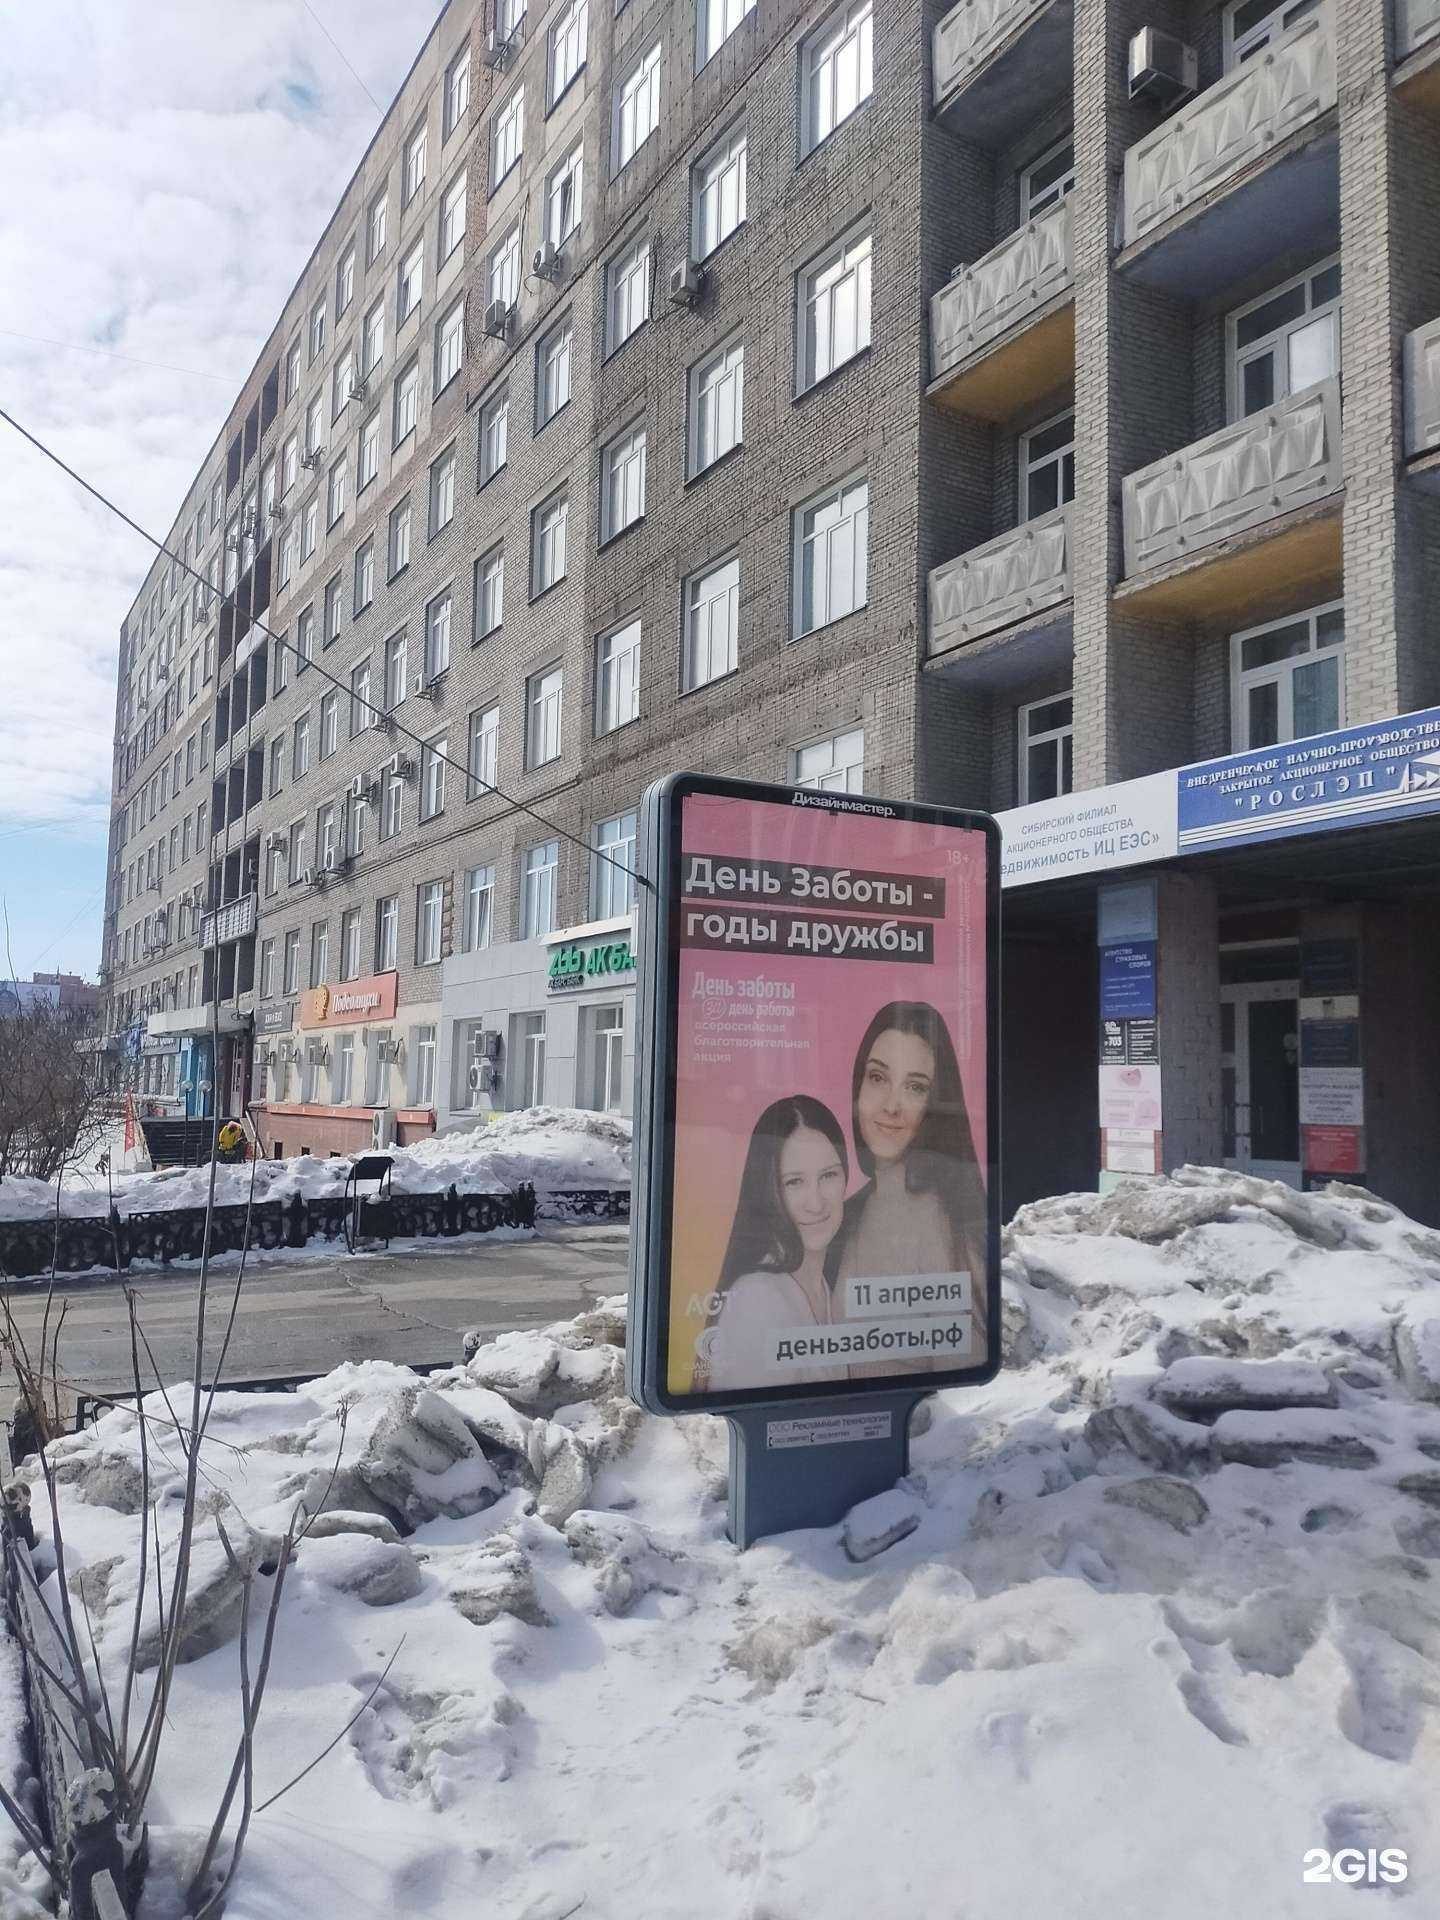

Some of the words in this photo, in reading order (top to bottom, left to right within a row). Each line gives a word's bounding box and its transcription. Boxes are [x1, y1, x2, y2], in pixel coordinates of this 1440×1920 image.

[1220, 775, 1274, 795] ЗАКРЫТОЕ
[1279, 754, 1364, 782] АКЦИОНЕРНОЕ
[1370, 738, 1440, 761] ОБЩЕСТВО
[791, 791, 896, 817] Дизайнмастер.
[1020, 814, 1075, 836] СИБИРСКИЙ
[1076, 804, 1118, 822] ФИЛИАЛ
[1006, 830, 1077, 855] АКЦИОНЕРНОГО
[1079, 818, 1134, 838] ОБЩЕСТВА
[1094, 839, 1115, 857] ИЦ
[948, 850, 970, 865] 18+
[685, 857, 781, 895] День
[790, 867, 914, 906] Заботы
[687, 912, 777, 944] годы
[787, 920, 925, 955] дружбы
[691, 971, 735, 999] День
[736, 974, 796, 999] заботы
[854, 1285, 870, 1306] 11
[878, 1283, 962, 1307] апреля
[776, 1322, 963, 1361] деньзаботы.рф
